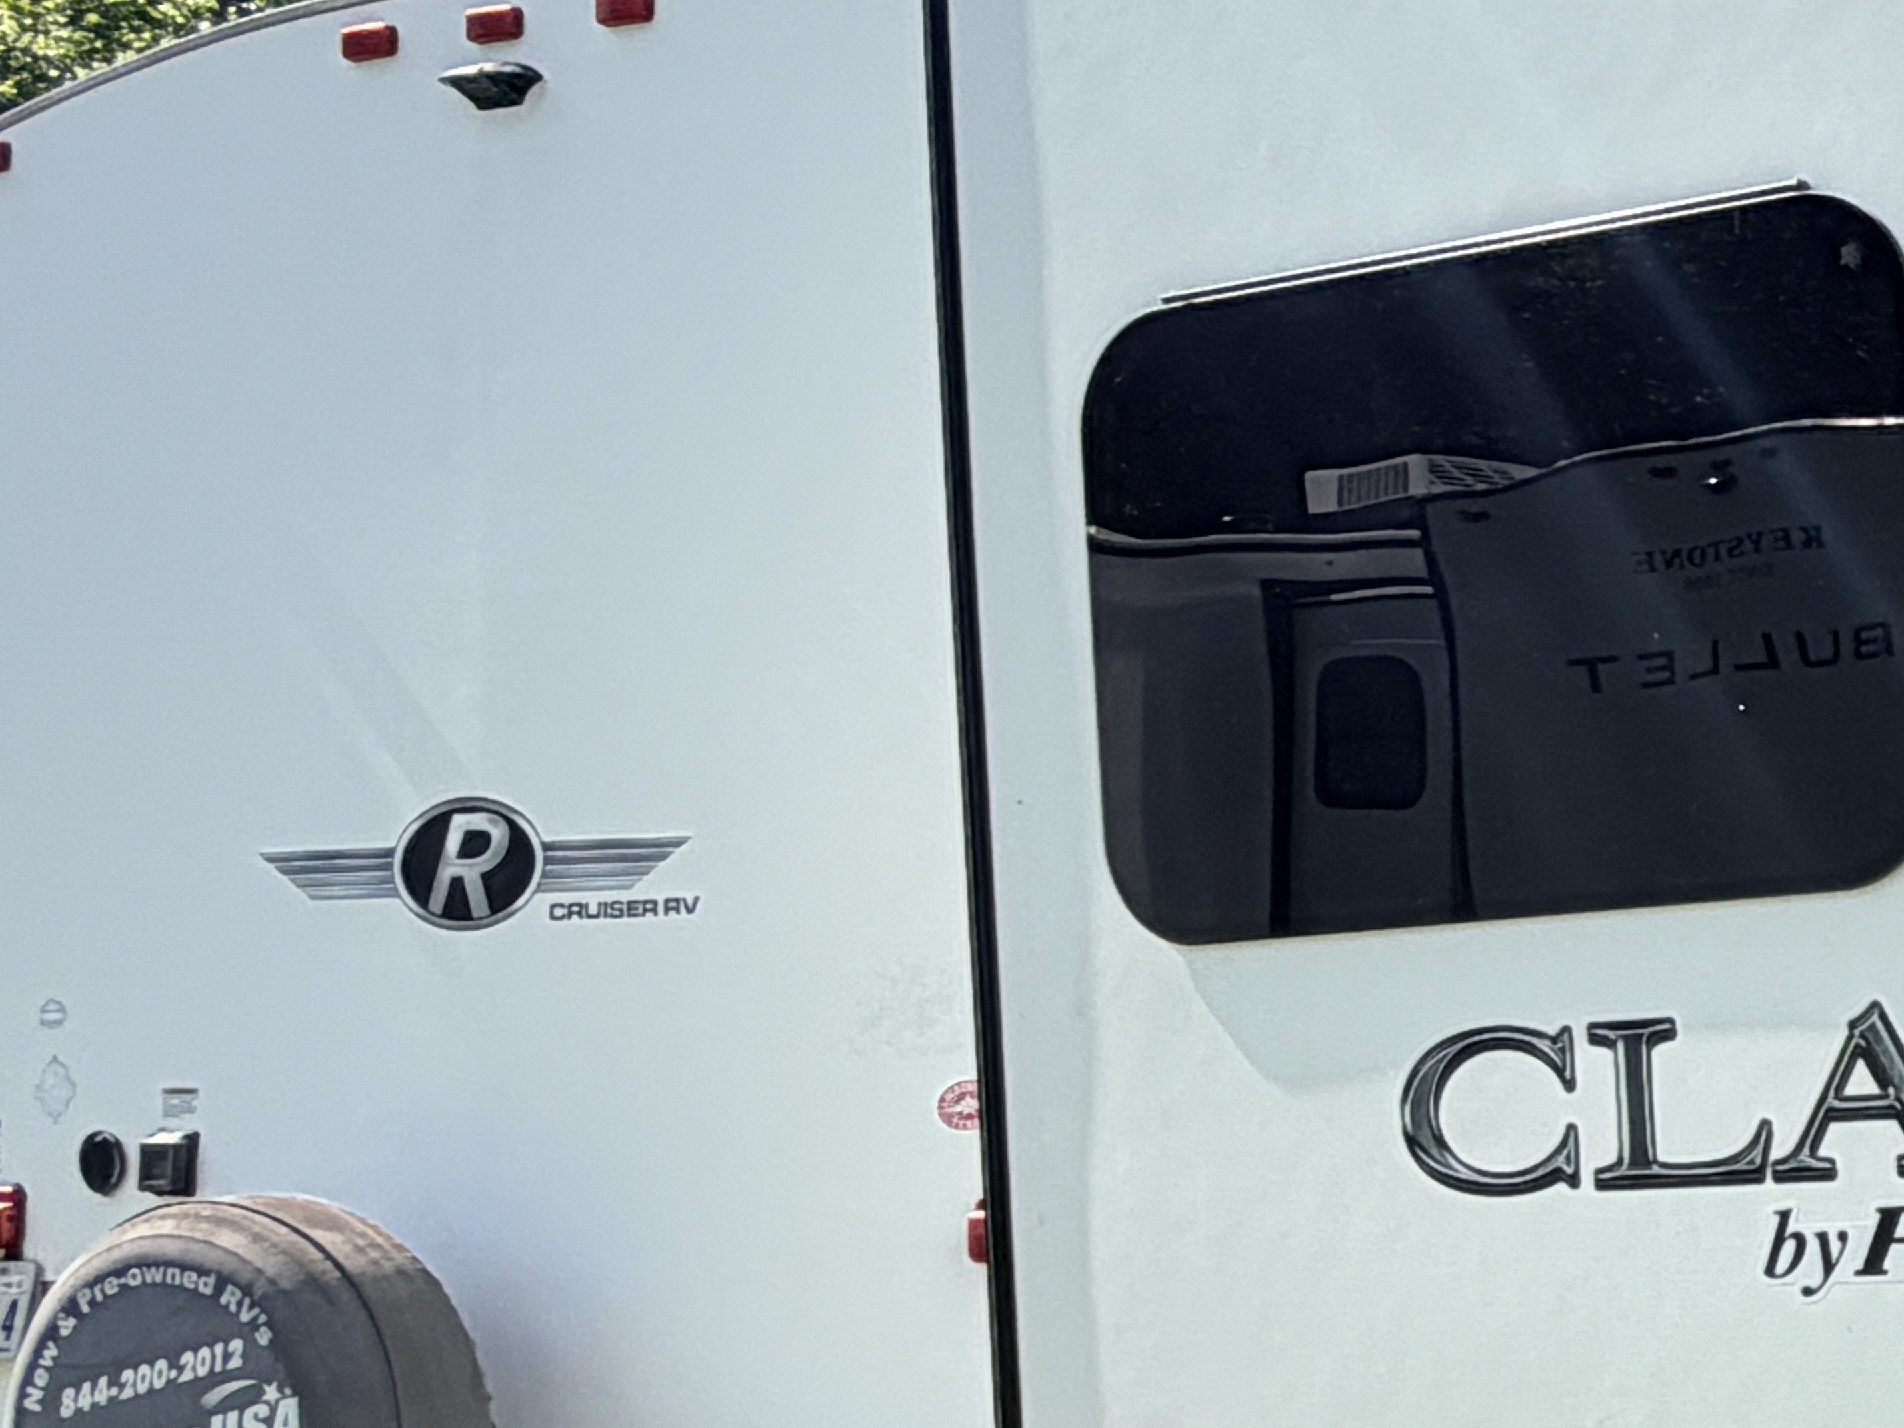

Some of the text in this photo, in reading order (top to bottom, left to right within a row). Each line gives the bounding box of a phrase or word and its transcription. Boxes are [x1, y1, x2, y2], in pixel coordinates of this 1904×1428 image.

[548, 896, 700, 922] CRUISER RV
[1763, 1207, 1850, 1298] by
[22, 1266, 273, 1412] New & Pre-owned RV's
[58, 1338, 245, 1419] 844-200-2012
